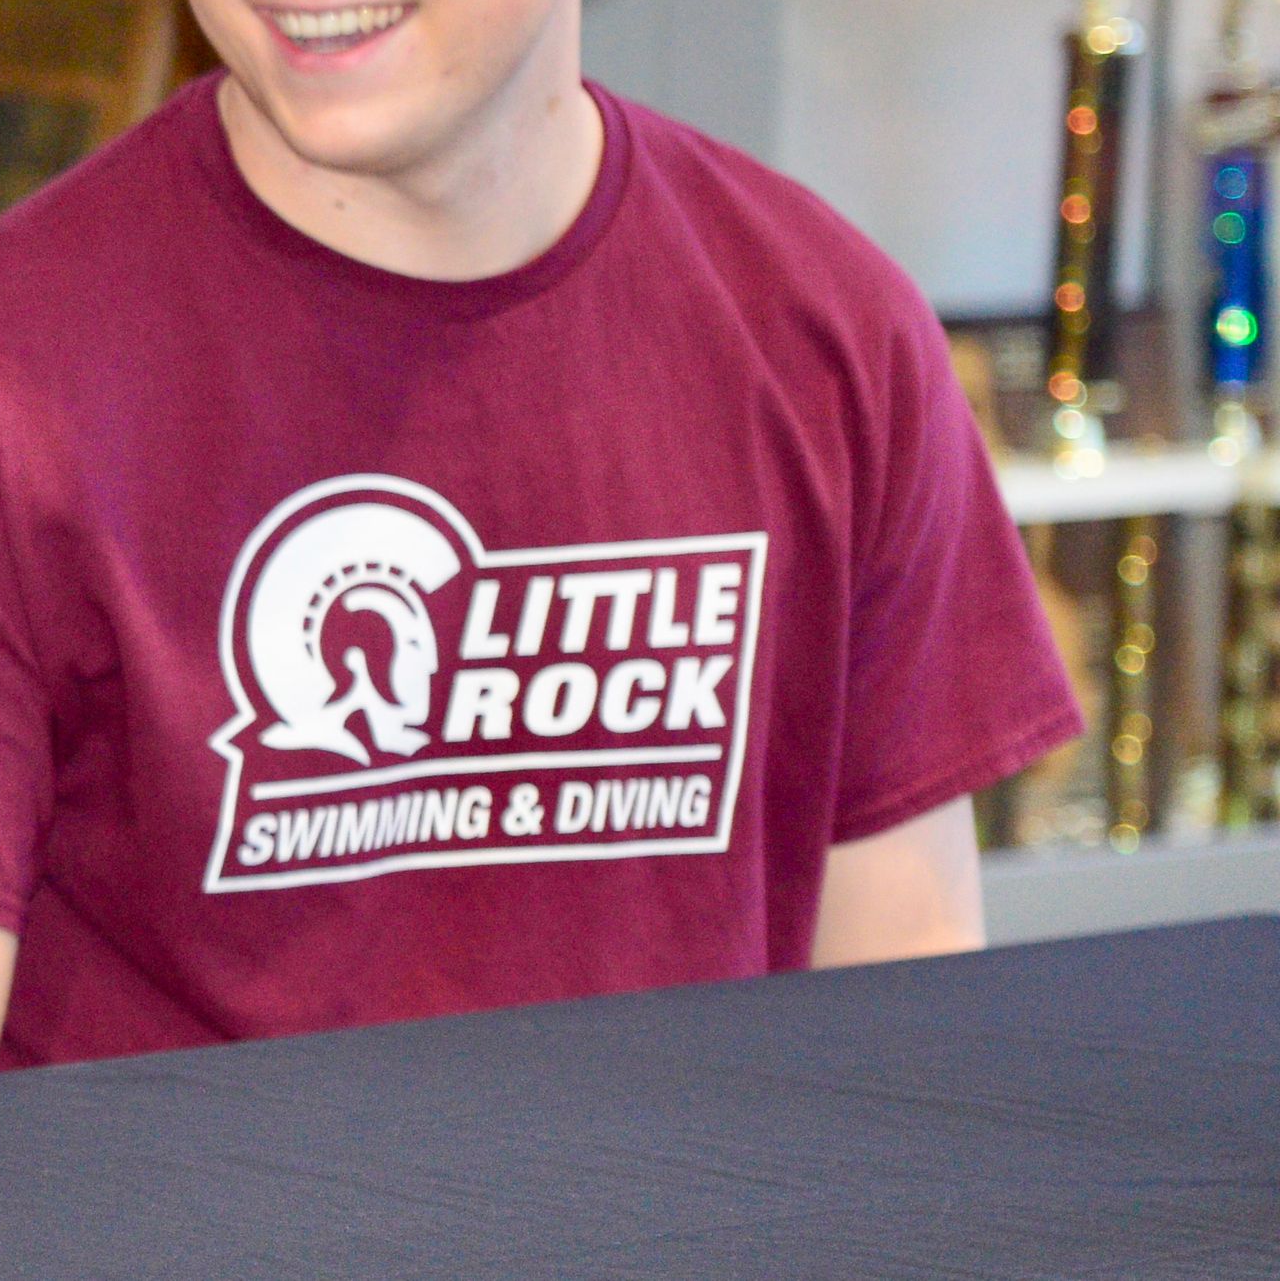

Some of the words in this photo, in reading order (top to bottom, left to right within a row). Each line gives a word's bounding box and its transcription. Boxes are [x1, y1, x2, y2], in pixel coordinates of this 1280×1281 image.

[458, 561, 745, 661] LITTLE
[441, 655, 736, 744] ROCK
[236, 784, 494, 867] SWIMMING
[500, 783, 546, 838] &
[554, 774, 713, 835] DIVING
